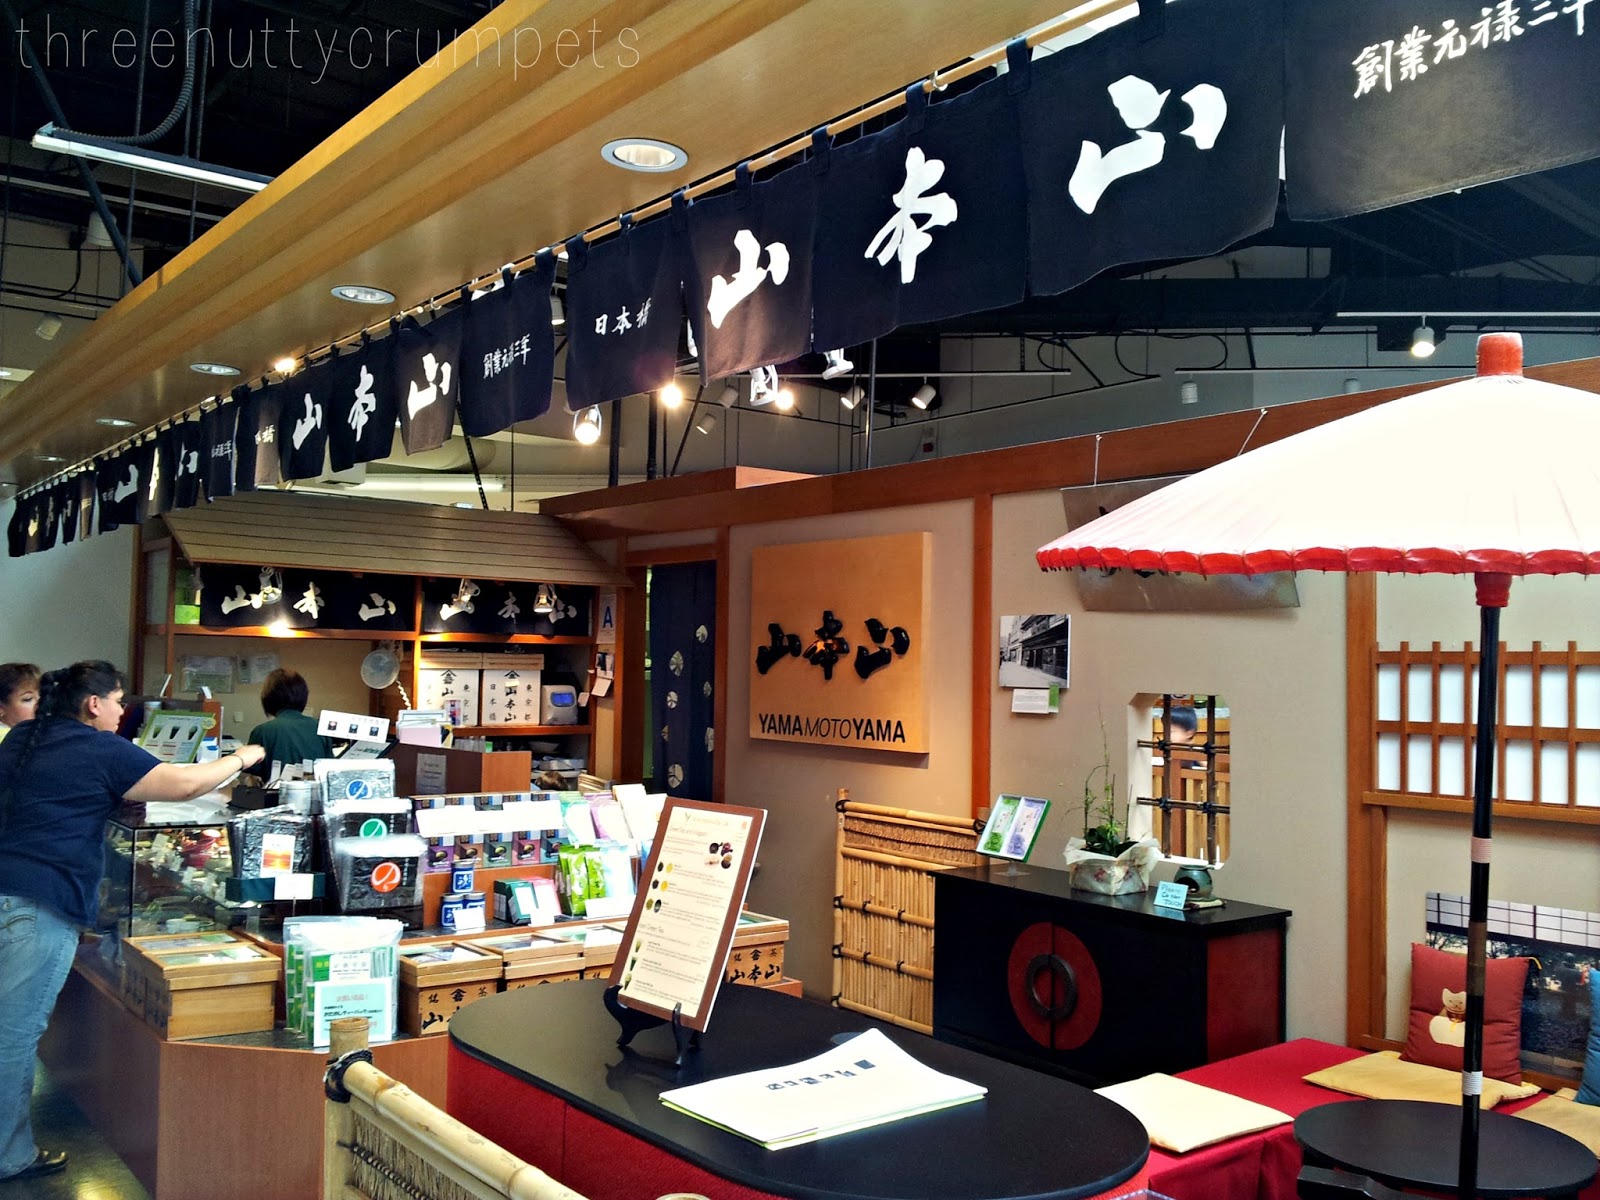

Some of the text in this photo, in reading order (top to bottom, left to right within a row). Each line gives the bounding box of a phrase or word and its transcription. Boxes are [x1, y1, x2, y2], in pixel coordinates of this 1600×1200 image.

[595, 297, 652, 335] 日本橋
[755, 610, 910, 680] 山本山
[759, 713, 906, 743] YAMAMOTOYAMA
